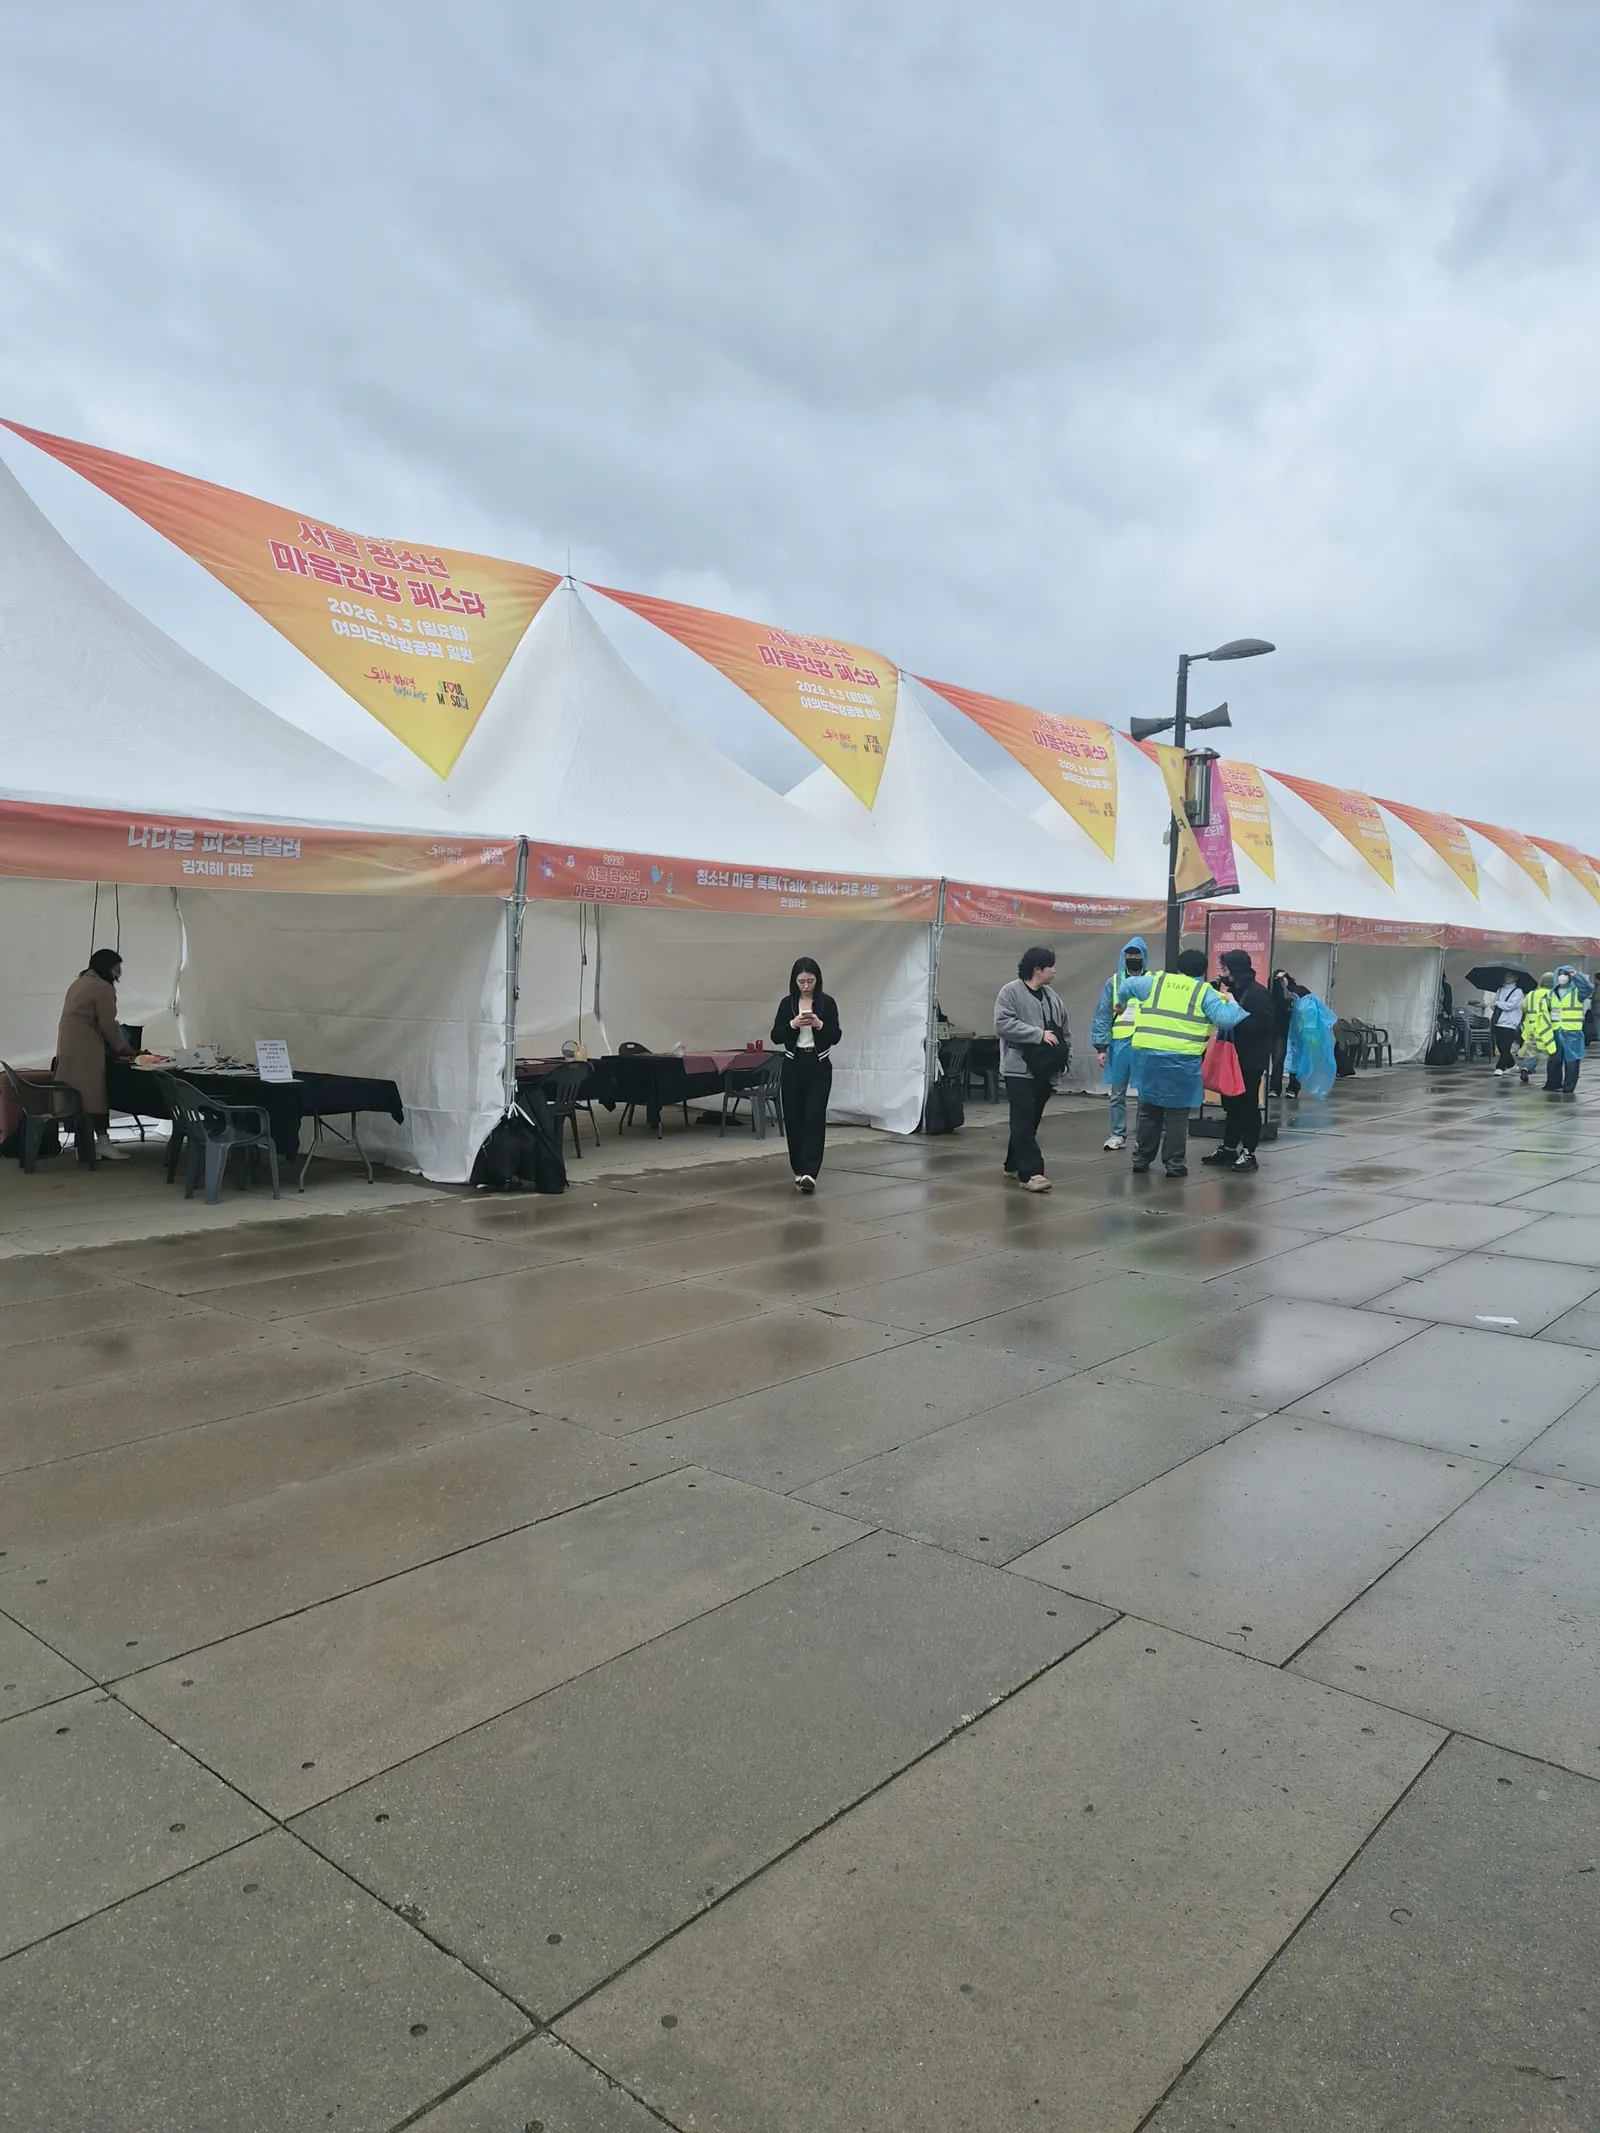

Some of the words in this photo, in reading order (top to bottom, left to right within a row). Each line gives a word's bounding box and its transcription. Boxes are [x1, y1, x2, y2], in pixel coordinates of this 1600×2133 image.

[298, 521, 362, 561] 서울
[365, 541, 451, 579] 청소년
[268, 539, 402, 603] 마음건강
[406, 579, 487, 619] 페스타
[332, 619, 443, 658] 여의도한강공원
[448, 645, 474, 663] 일원
[417, 621, 469, 643] (일요일)
[804, 640, 855, 661] 청소년
[758, 645, 834, 679] 마음건강
[835, 663, 881, 688] 페스타
[127, 825, 195, 851] 나다운
[201, 831, 302, 859] 퍼스널컬러
[228, 862, 254, 878] 대표
[603, 854, 625, 866] 2026
[587, 865, 608, 882] 서울
[610, 867, 641, 884] 청소년
[696, 868, 729, 887] 청소년
[732, 872, 755, 889] 마음
[572, 882, 617, 900] 마음건강
[618, 887, 651, 903] 페스타
[1166, 981, 1191, 992] STAFF
